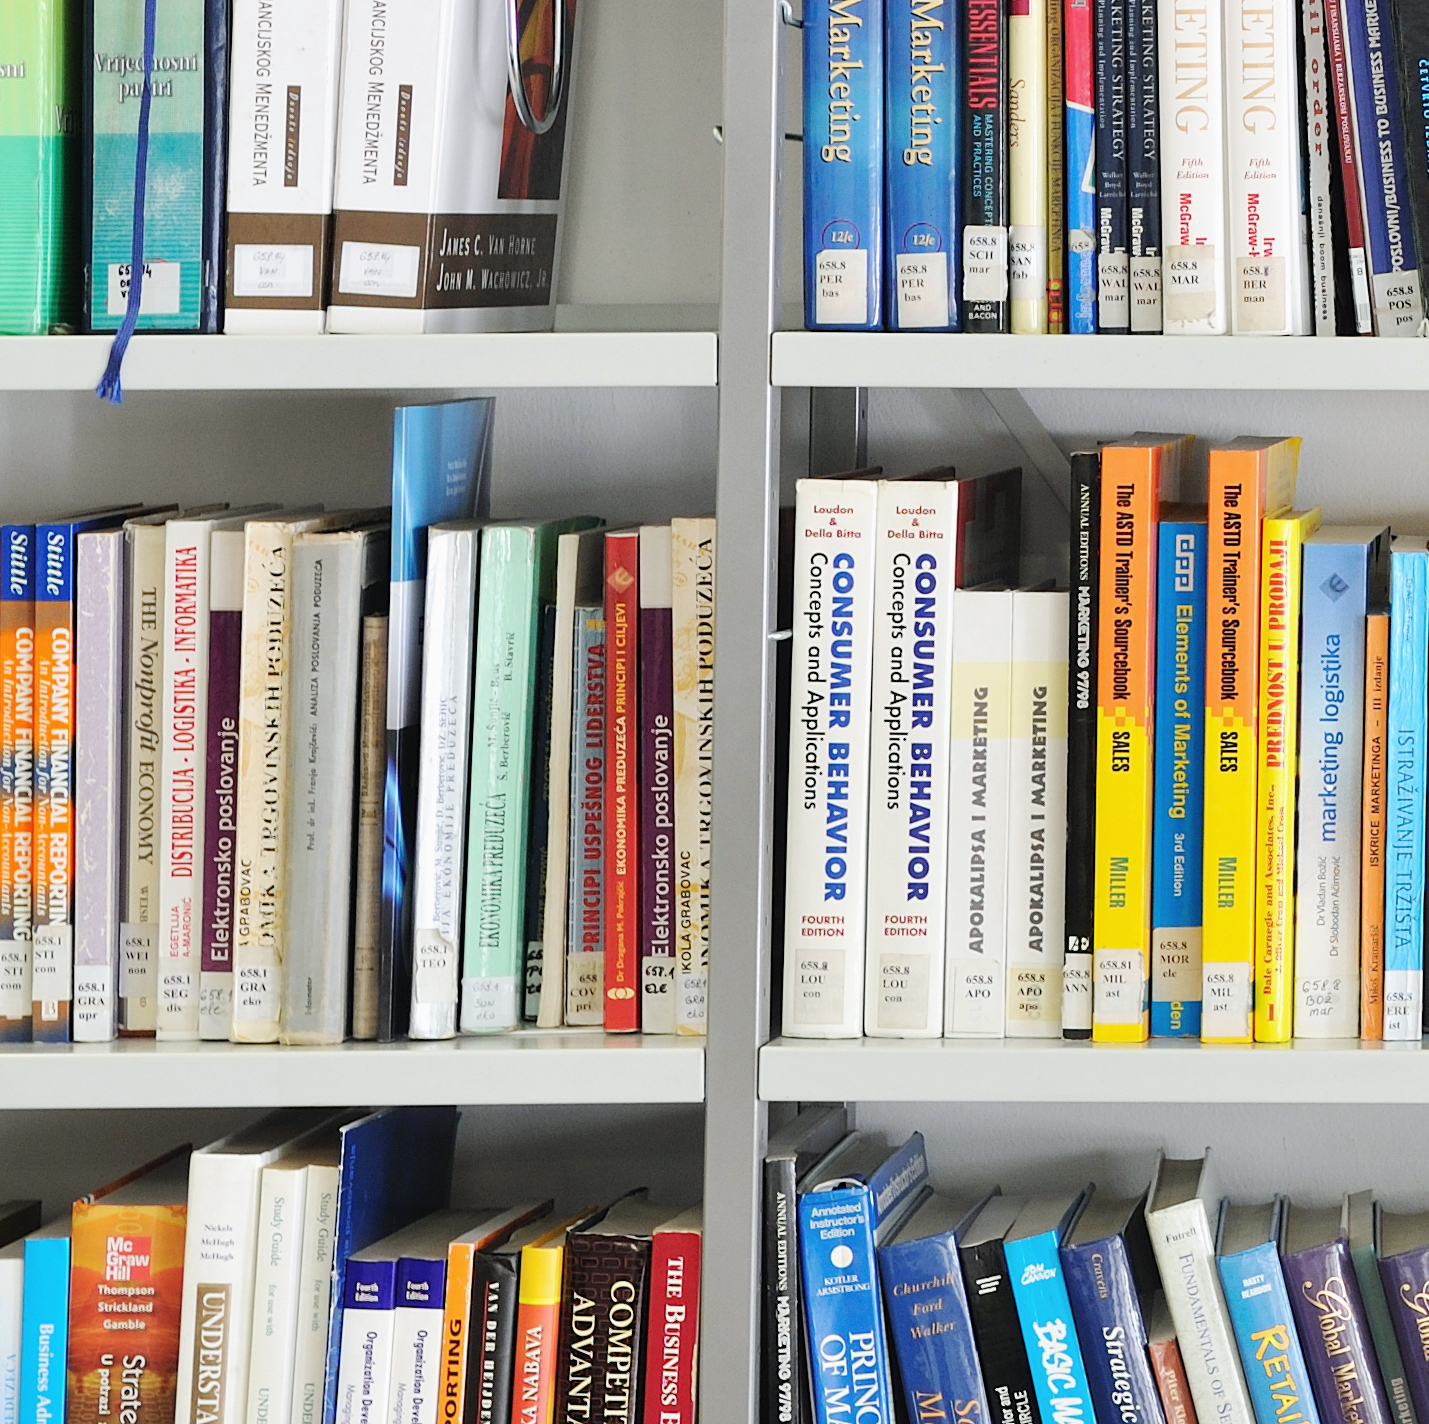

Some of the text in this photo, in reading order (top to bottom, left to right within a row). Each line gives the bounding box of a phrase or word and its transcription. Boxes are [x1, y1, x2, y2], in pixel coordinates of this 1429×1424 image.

[251, 83, 275, 187] MENEDŽMENTA
[44, 530, 66, 596] Stittle
[134, 586, 160, 865] THE Nonprofit ECONOMY
[824, 553, 856, 902] CONSUMER BEHAVIOR
[1168, 604, 1192, 819] Elements of Marketing
[97, 1285, 155, 1299] Thompson
[892, 1284, 956, 1298] Churchill
[1090, 1253, 1110, 1299] Cravens
[97, 1301, 154, 1314] Strickland
[103, 1318, 146, 1332] Gamble
